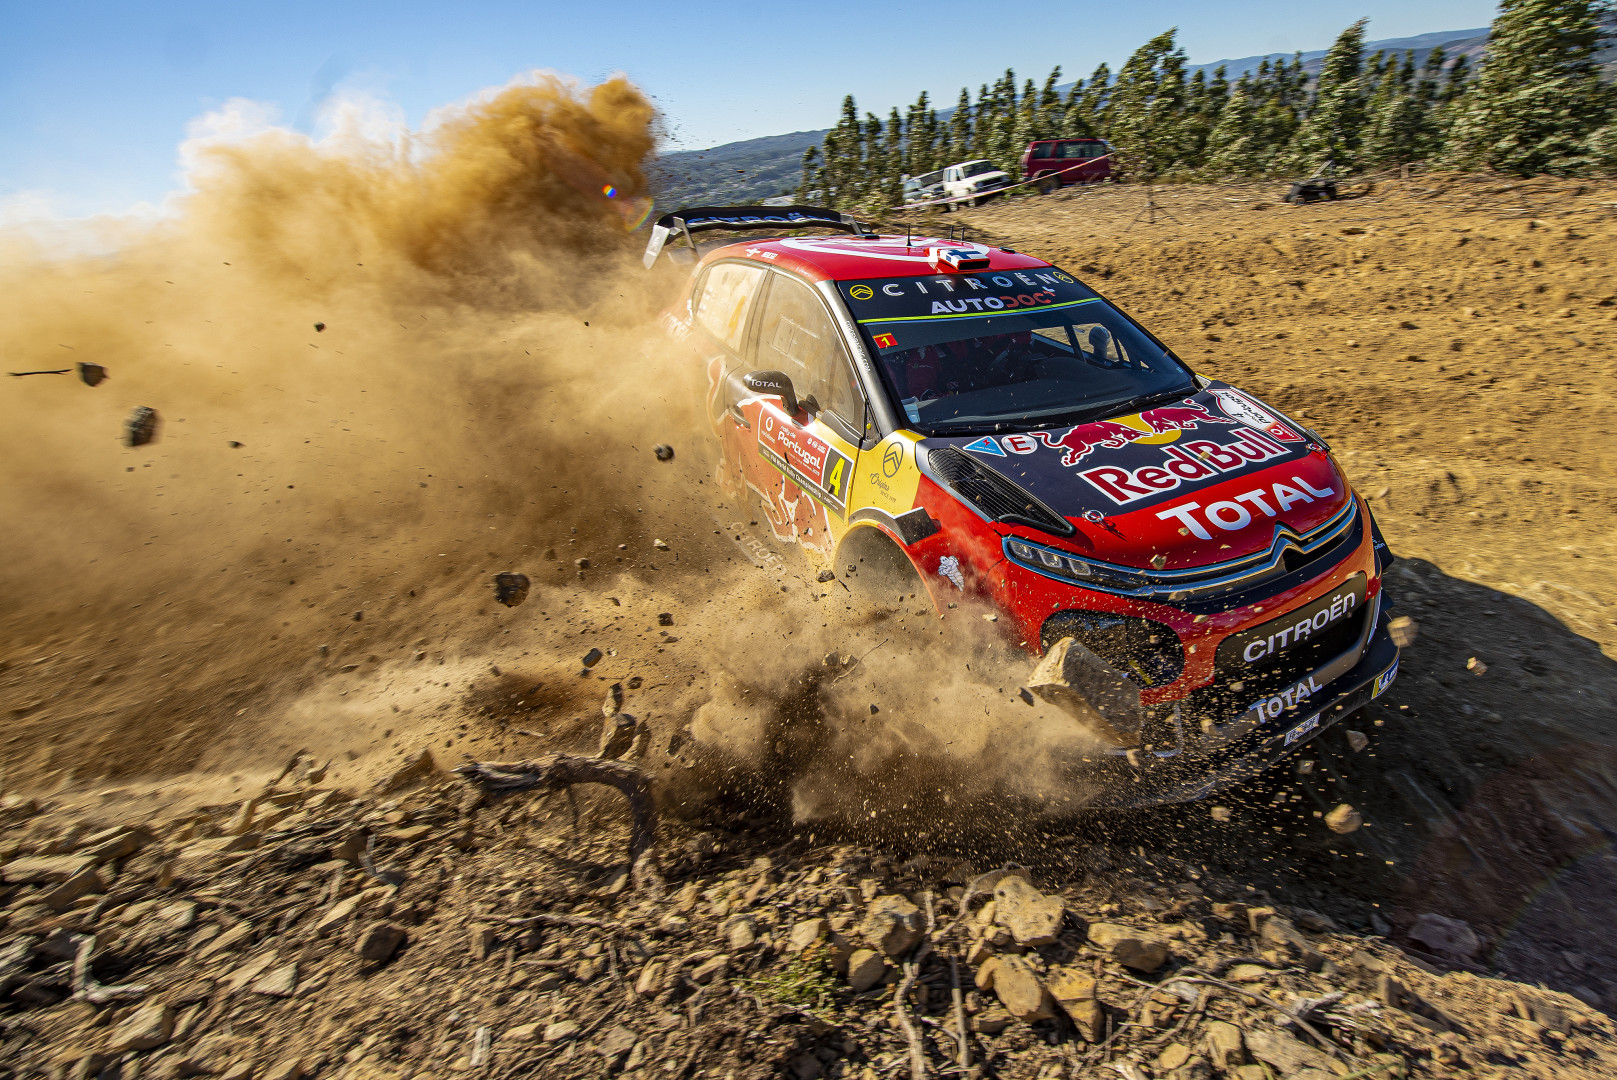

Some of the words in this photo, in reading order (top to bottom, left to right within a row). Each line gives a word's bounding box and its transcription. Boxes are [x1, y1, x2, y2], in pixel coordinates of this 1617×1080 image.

[882, 272, 1060, 297] CITROËN
[881, 336, 891, 346] 1
[750, 378, 782, 389] TOTAL
[777, 430, 821, 470] Portugal
[1007, 436, 1032, 452] E
[829, 457, 846, 496] 4
[1155, 476, 1335, 540] TOTAL
[1248, 676, 1323, 724] TOTAL
